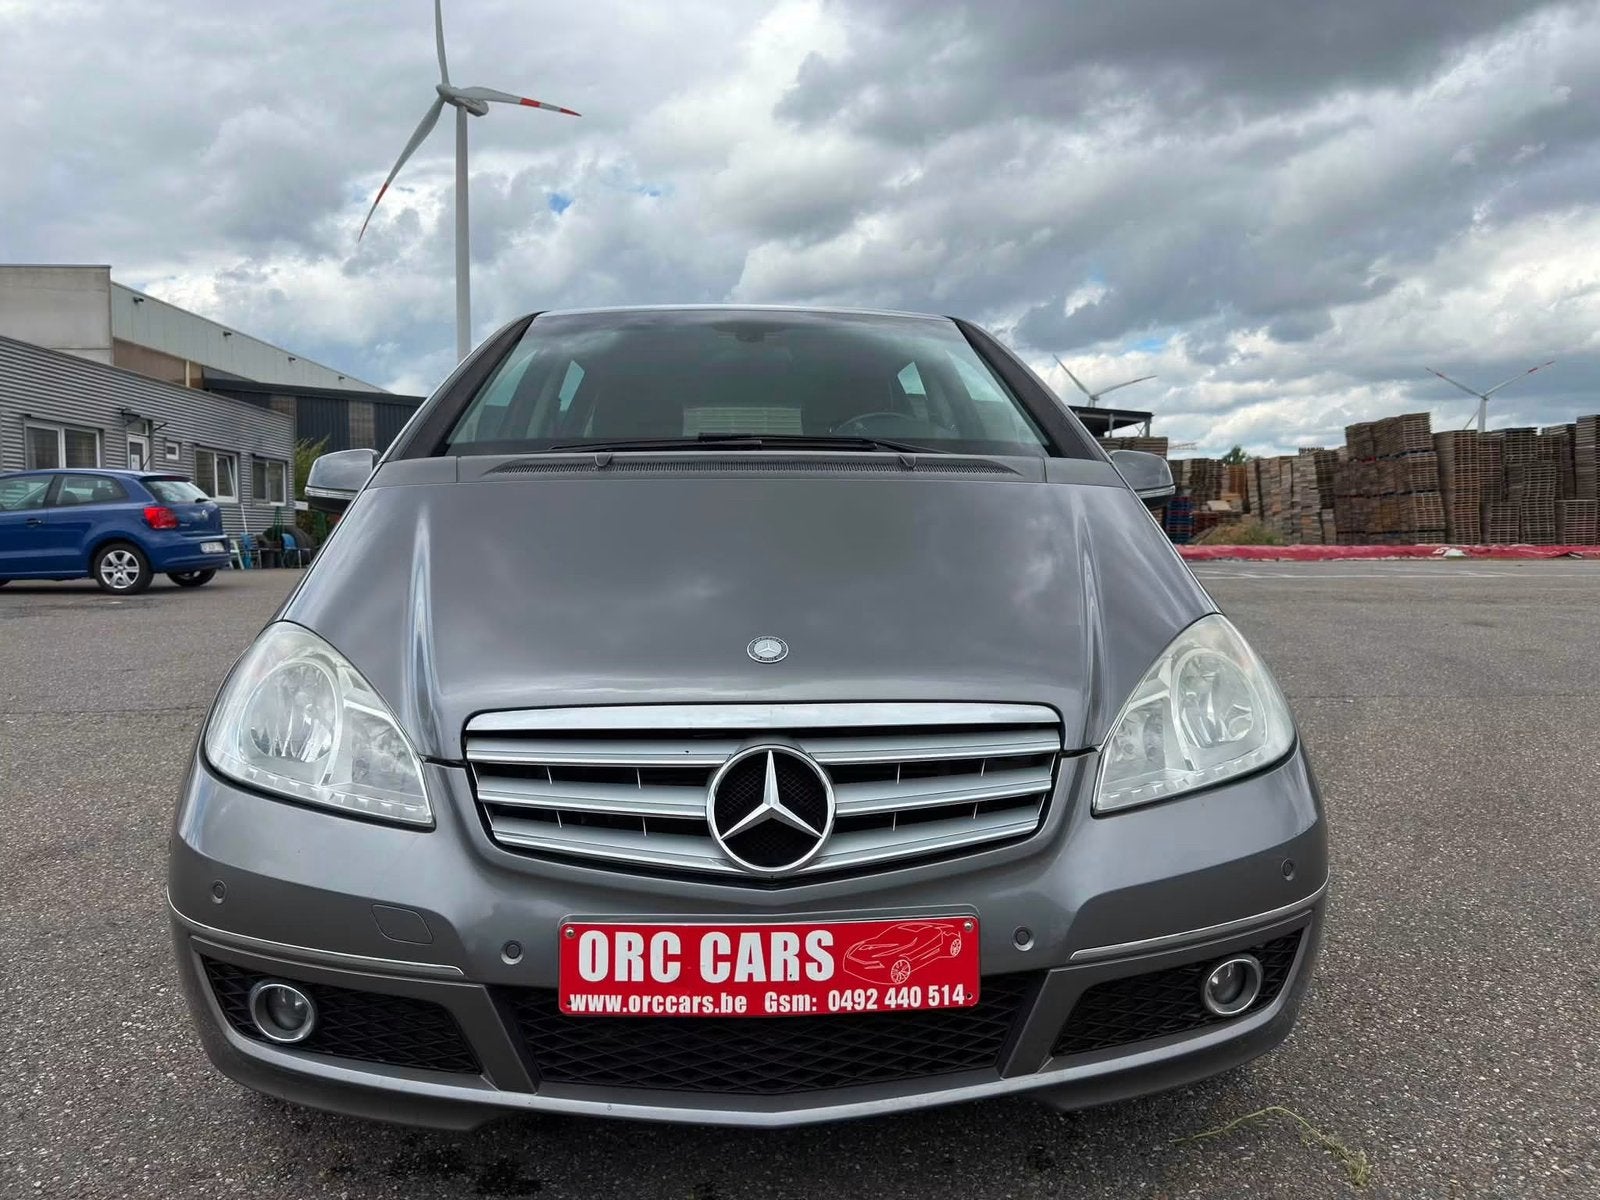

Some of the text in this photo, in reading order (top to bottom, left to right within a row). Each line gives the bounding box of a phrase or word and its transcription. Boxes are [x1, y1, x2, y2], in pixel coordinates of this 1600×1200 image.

[579, 930, 834, 983] ORC CARS
[570, 992, 747, 1014] www.orccars.be
[764, 983, 965, 1013] Gsm: 0492 440 514
